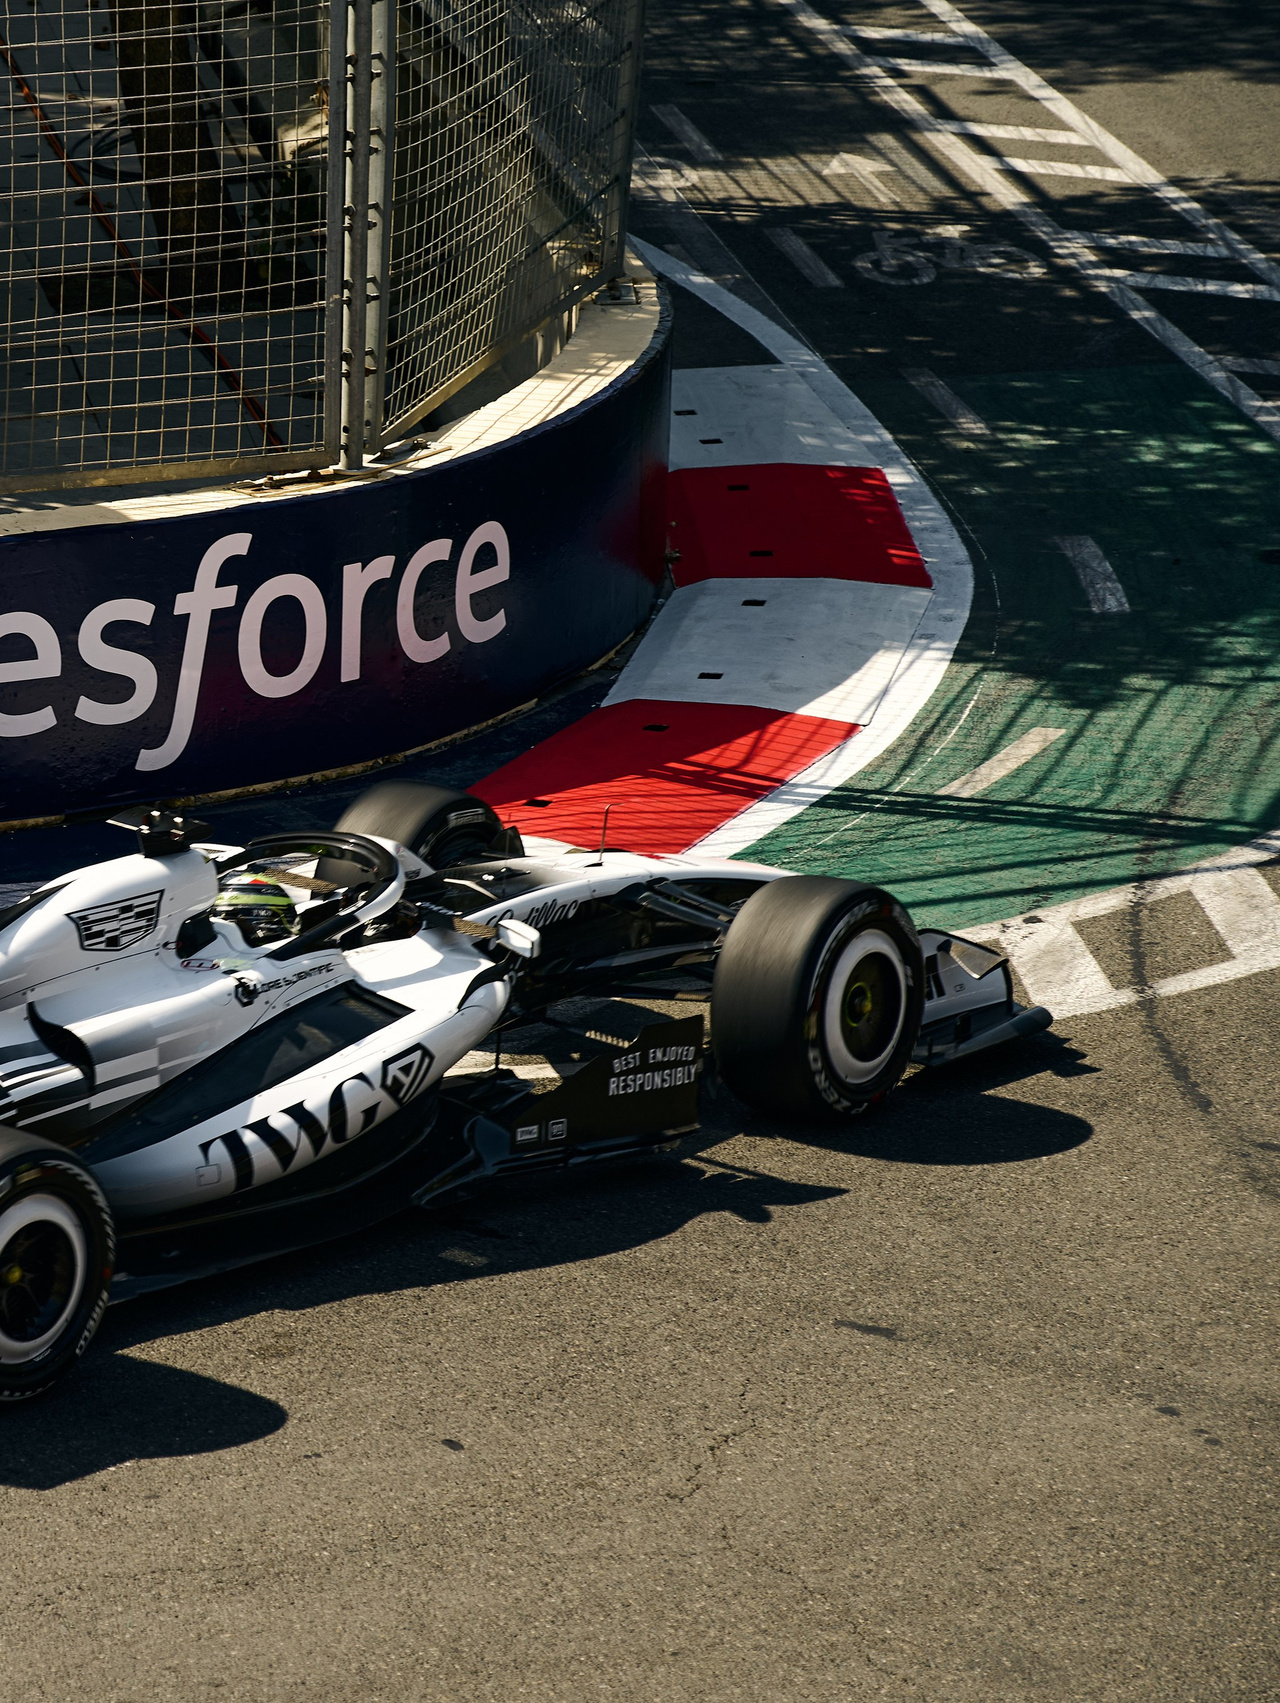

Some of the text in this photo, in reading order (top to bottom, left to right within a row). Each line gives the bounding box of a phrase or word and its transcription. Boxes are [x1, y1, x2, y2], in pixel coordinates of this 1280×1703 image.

[486, 898, 579, 932] Cdillac
[612, 1045, 697, 1074] BEST ENJOYED
[608, 1063, 699, 1097] RESPONSIBLY
[198, 1071, 383, 1195] TWG
